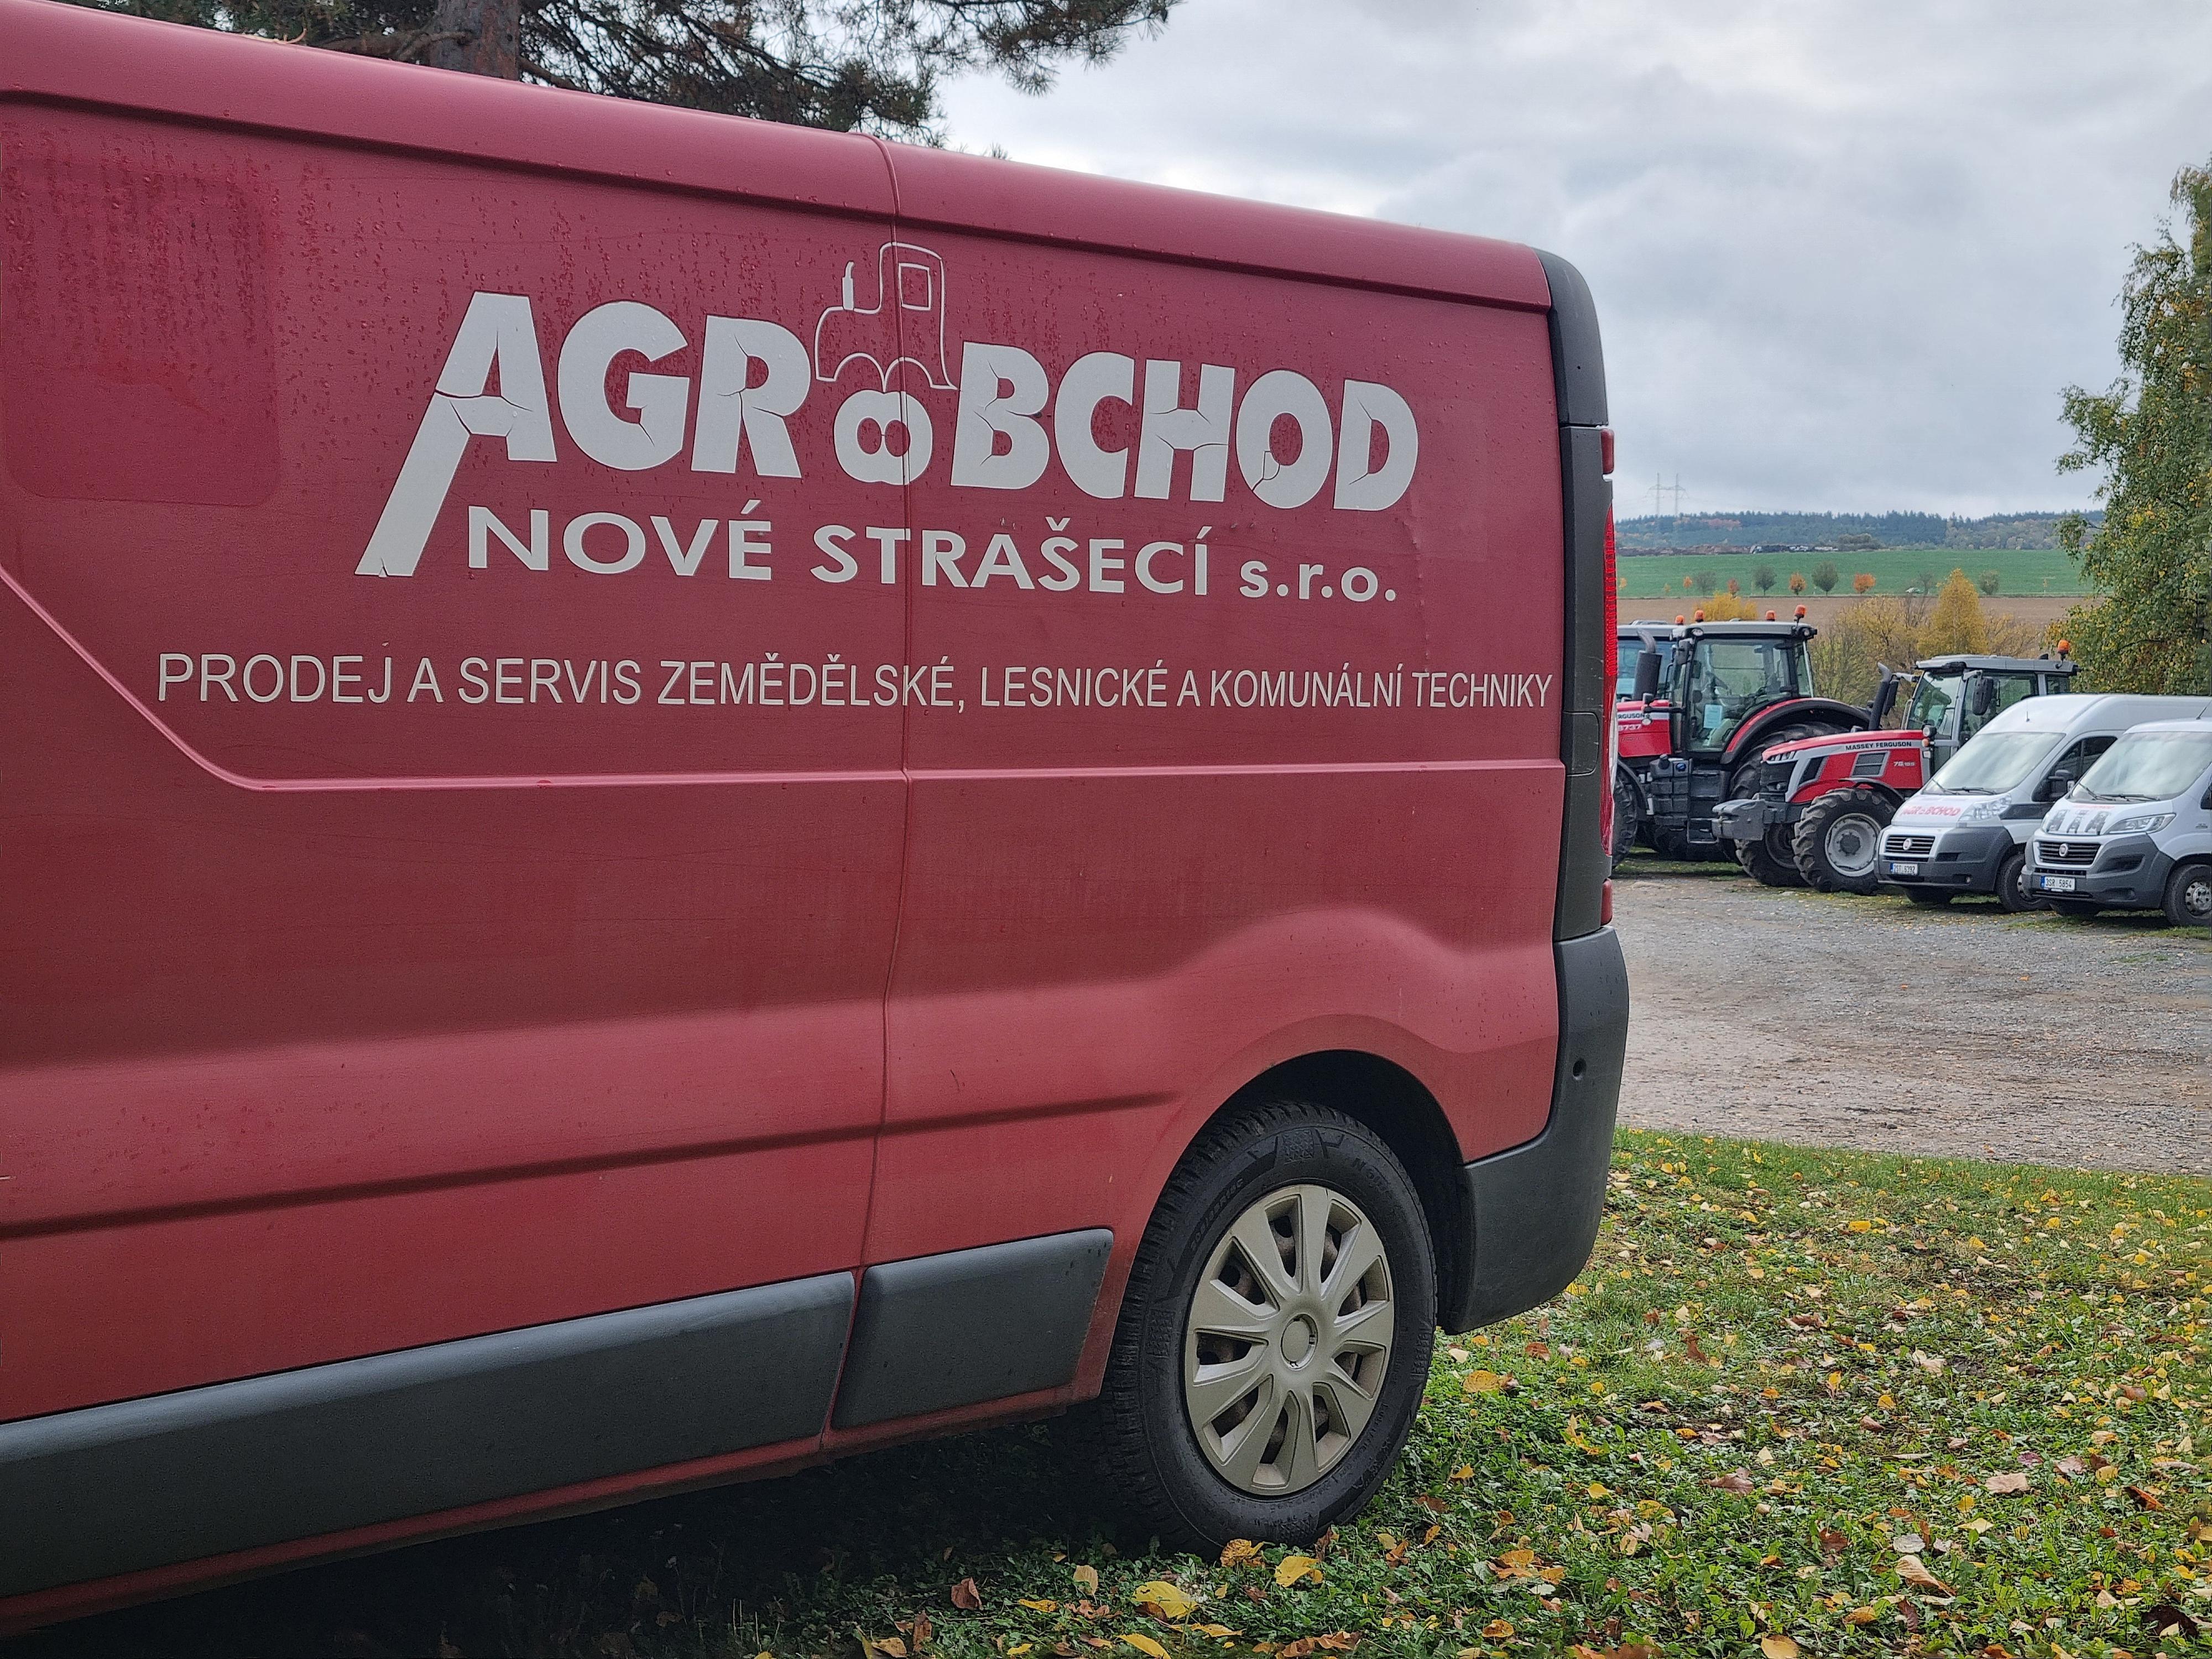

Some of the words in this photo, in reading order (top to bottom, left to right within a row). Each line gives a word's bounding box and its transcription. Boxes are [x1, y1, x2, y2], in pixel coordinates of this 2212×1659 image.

[468, 499, 771, 581] NOVÉ
[810, 517, 1212, 596] STRAŠECÍ
[1239, 560, 1396, 602] s.r.o.
[158, 653, 392, 703] PRODEJ
[406, 658, 444, 703] A
[458, 657, 641, 705] SERVIS
[658, 652, 964, 713] ZEMĚDĚLSKÉ,
[981, 659, 1168, 707] LESNICKÉ
[1176, 670, 1201, 707] A
[1210, 663, 1402, 707] KOMUNÁLNÍ
[1412, 672, 1553, 707] TECHNIKY
[2059, 879, 2072, 888] 5854
